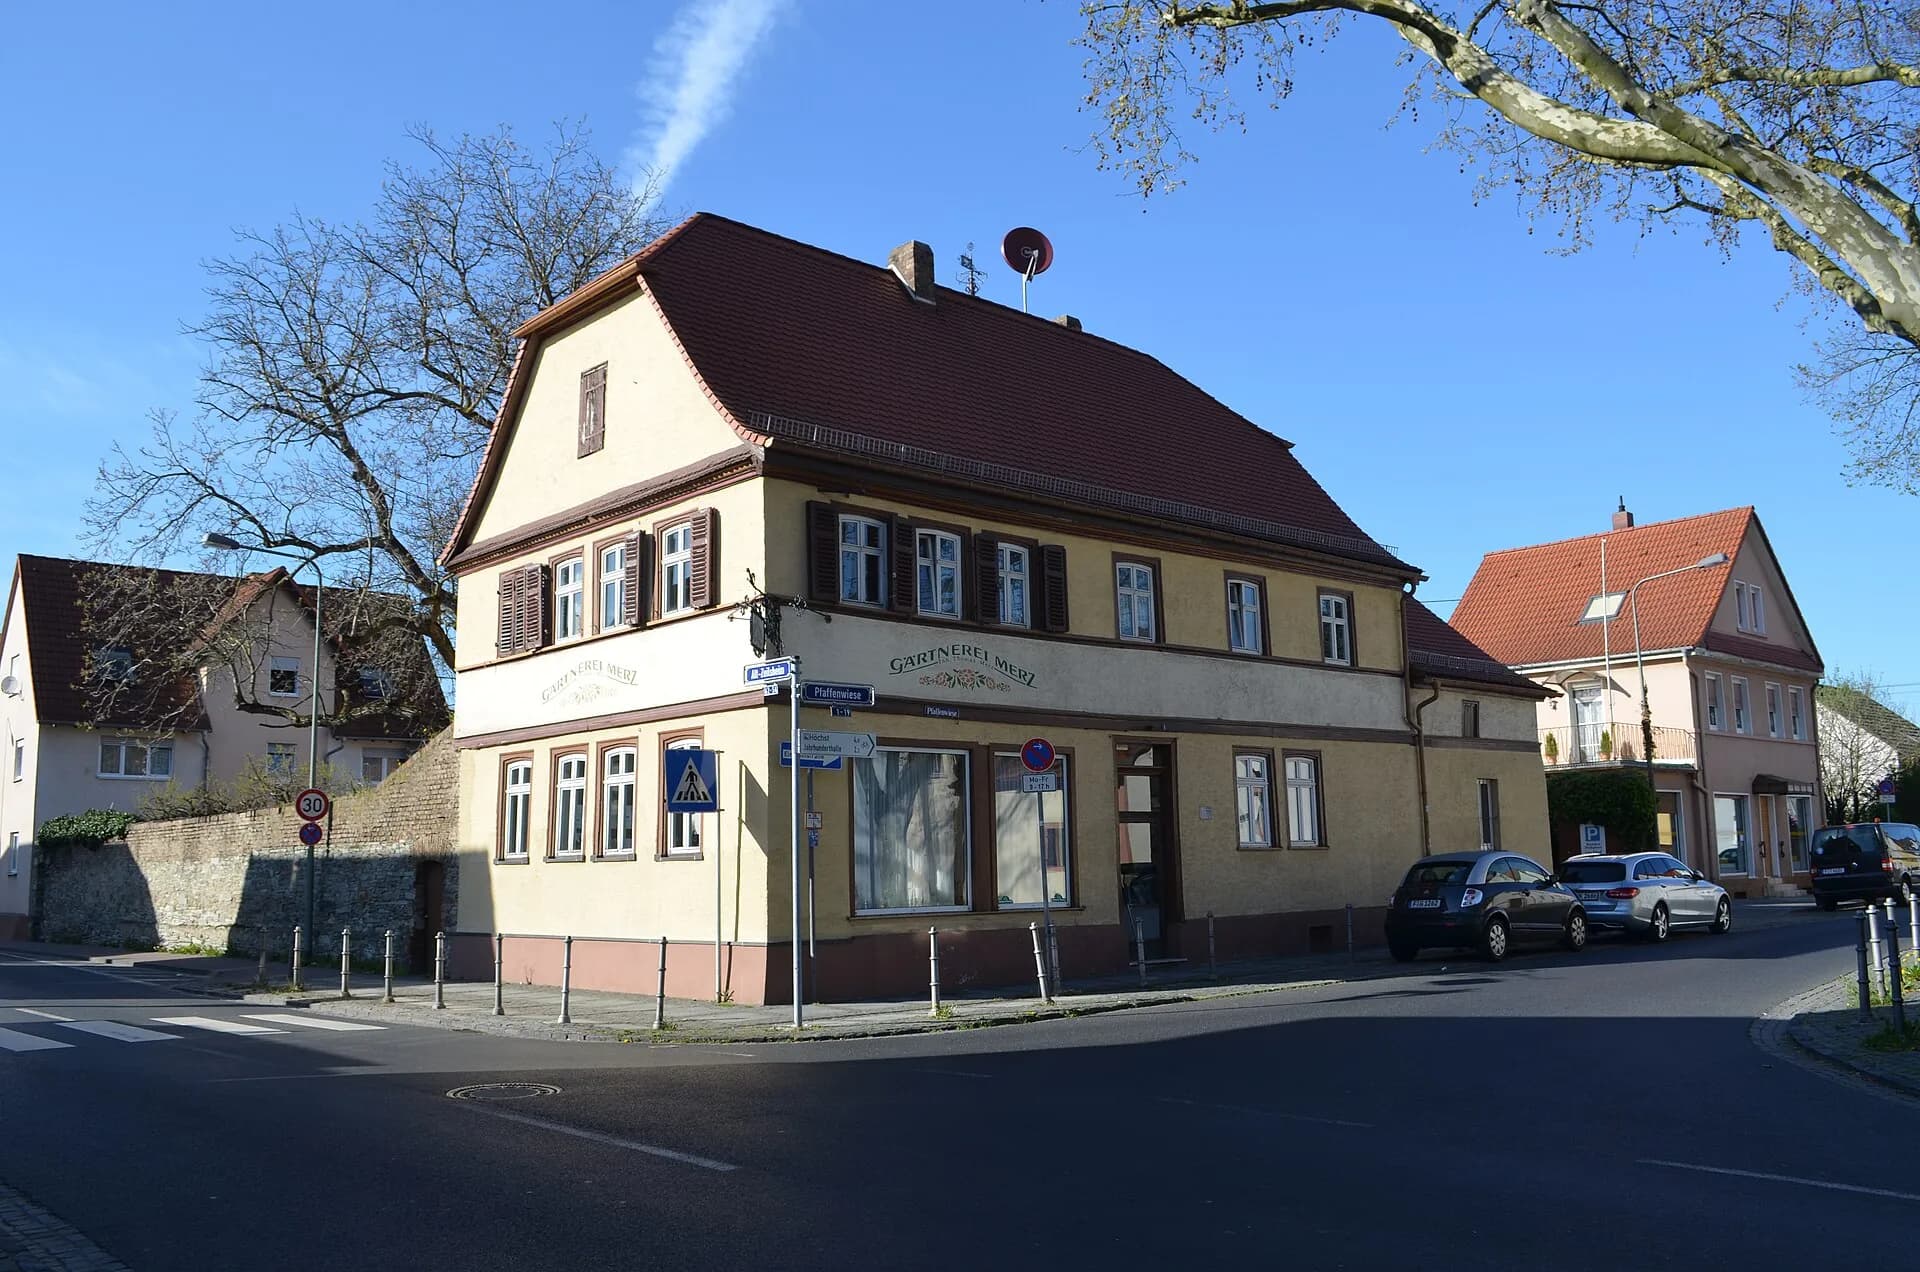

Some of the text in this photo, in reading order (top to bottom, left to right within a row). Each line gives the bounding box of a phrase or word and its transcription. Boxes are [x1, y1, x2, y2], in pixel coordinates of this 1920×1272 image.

[888, 643, 1038, 689] GÄRTNEREI MERZ
[607, 663, 639, 686] MERZ
[814, 686, 862, 700] Pfaffenwiese
[1029, 775, 1048, 783] Mo-Fr
[303, 798, 322, 812] 30
[1587, 827, 1598, 841] P
